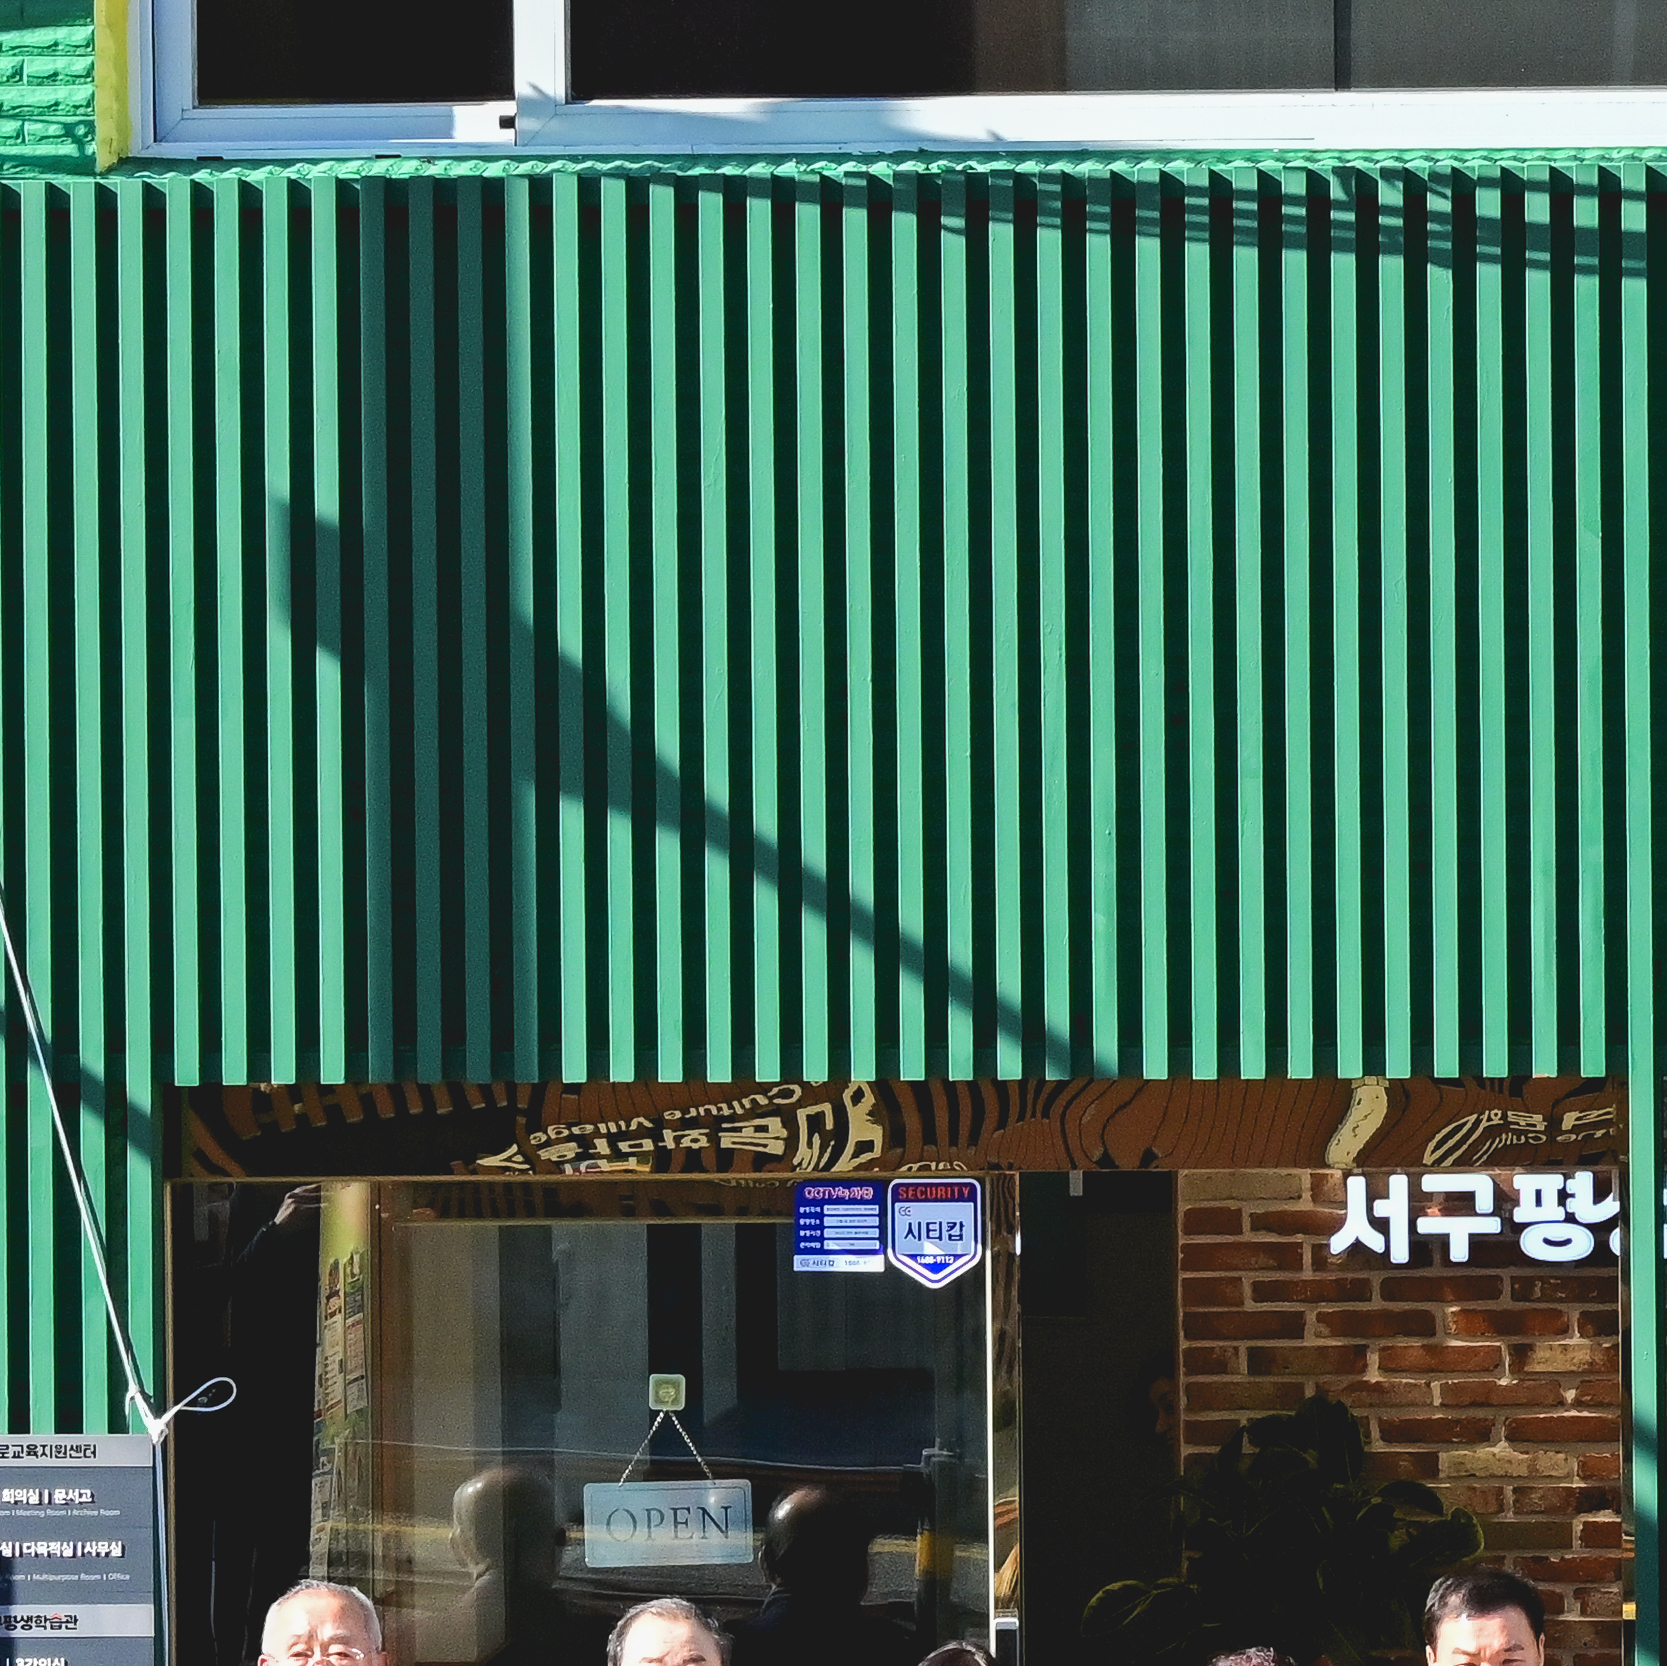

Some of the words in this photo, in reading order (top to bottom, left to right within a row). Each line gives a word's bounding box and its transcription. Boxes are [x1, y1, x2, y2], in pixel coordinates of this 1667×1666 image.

[898, 1187, 970, 1198] SECURITY
[904, 1221, 965, 1241] 시티캅
[605, 1505, 732, 1542] OPEN
[0, 1614, 78, 1630] 평생학습관
